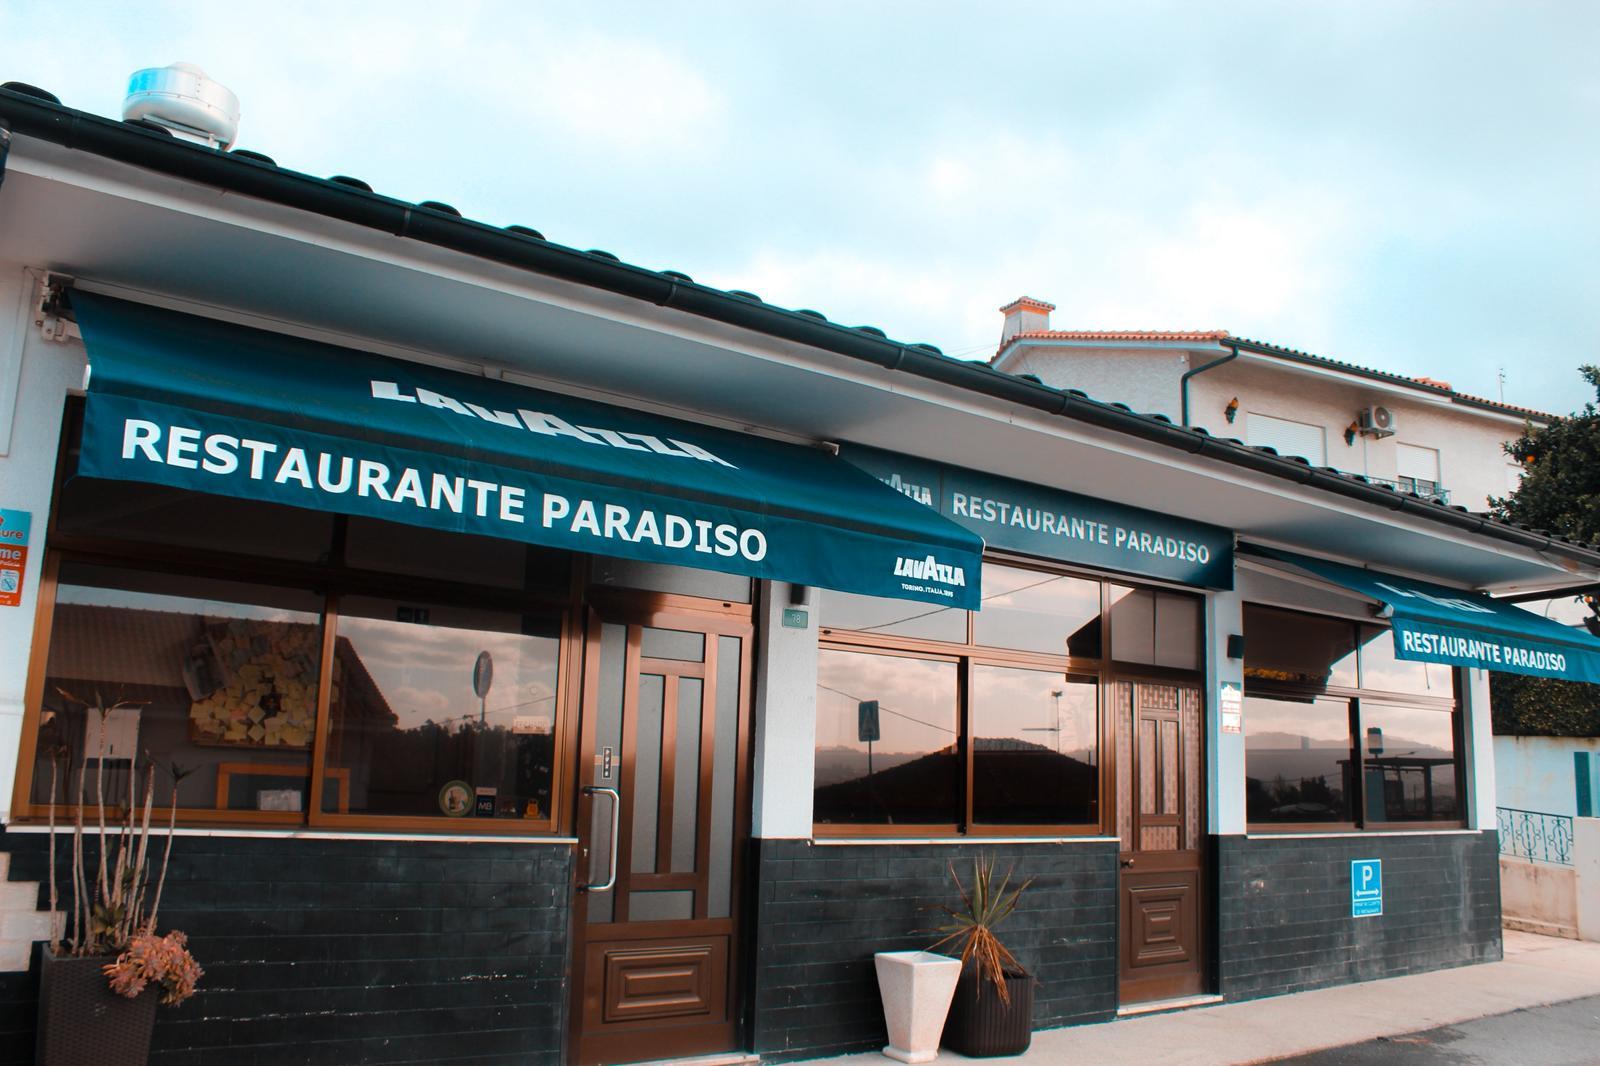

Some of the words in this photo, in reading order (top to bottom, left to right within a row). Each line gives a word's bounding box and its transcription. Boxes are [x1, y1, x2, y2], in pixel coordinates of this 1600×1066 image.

[370, 380, 738, 470] LAVAZZA
[122, 418, 526, 524] RESTAURANTE
[541, 493, 768, 563] PARADISO
[879, 473, 933, 506] AZZA
[0, 530, 23, 539] ure
[952, 493, 1110, 546] RESTAURANTE
[1114, 527, 1211, 565] PARADISO
[894, 556, 966, 587] LAVAZZA
[791, 614, 801, 624] 78
[1402, 630, 1502, 664] RESTAURANTE
[1503, 646, 1566, 673] PARADISO
[1362, 866, 1373, 890] P
